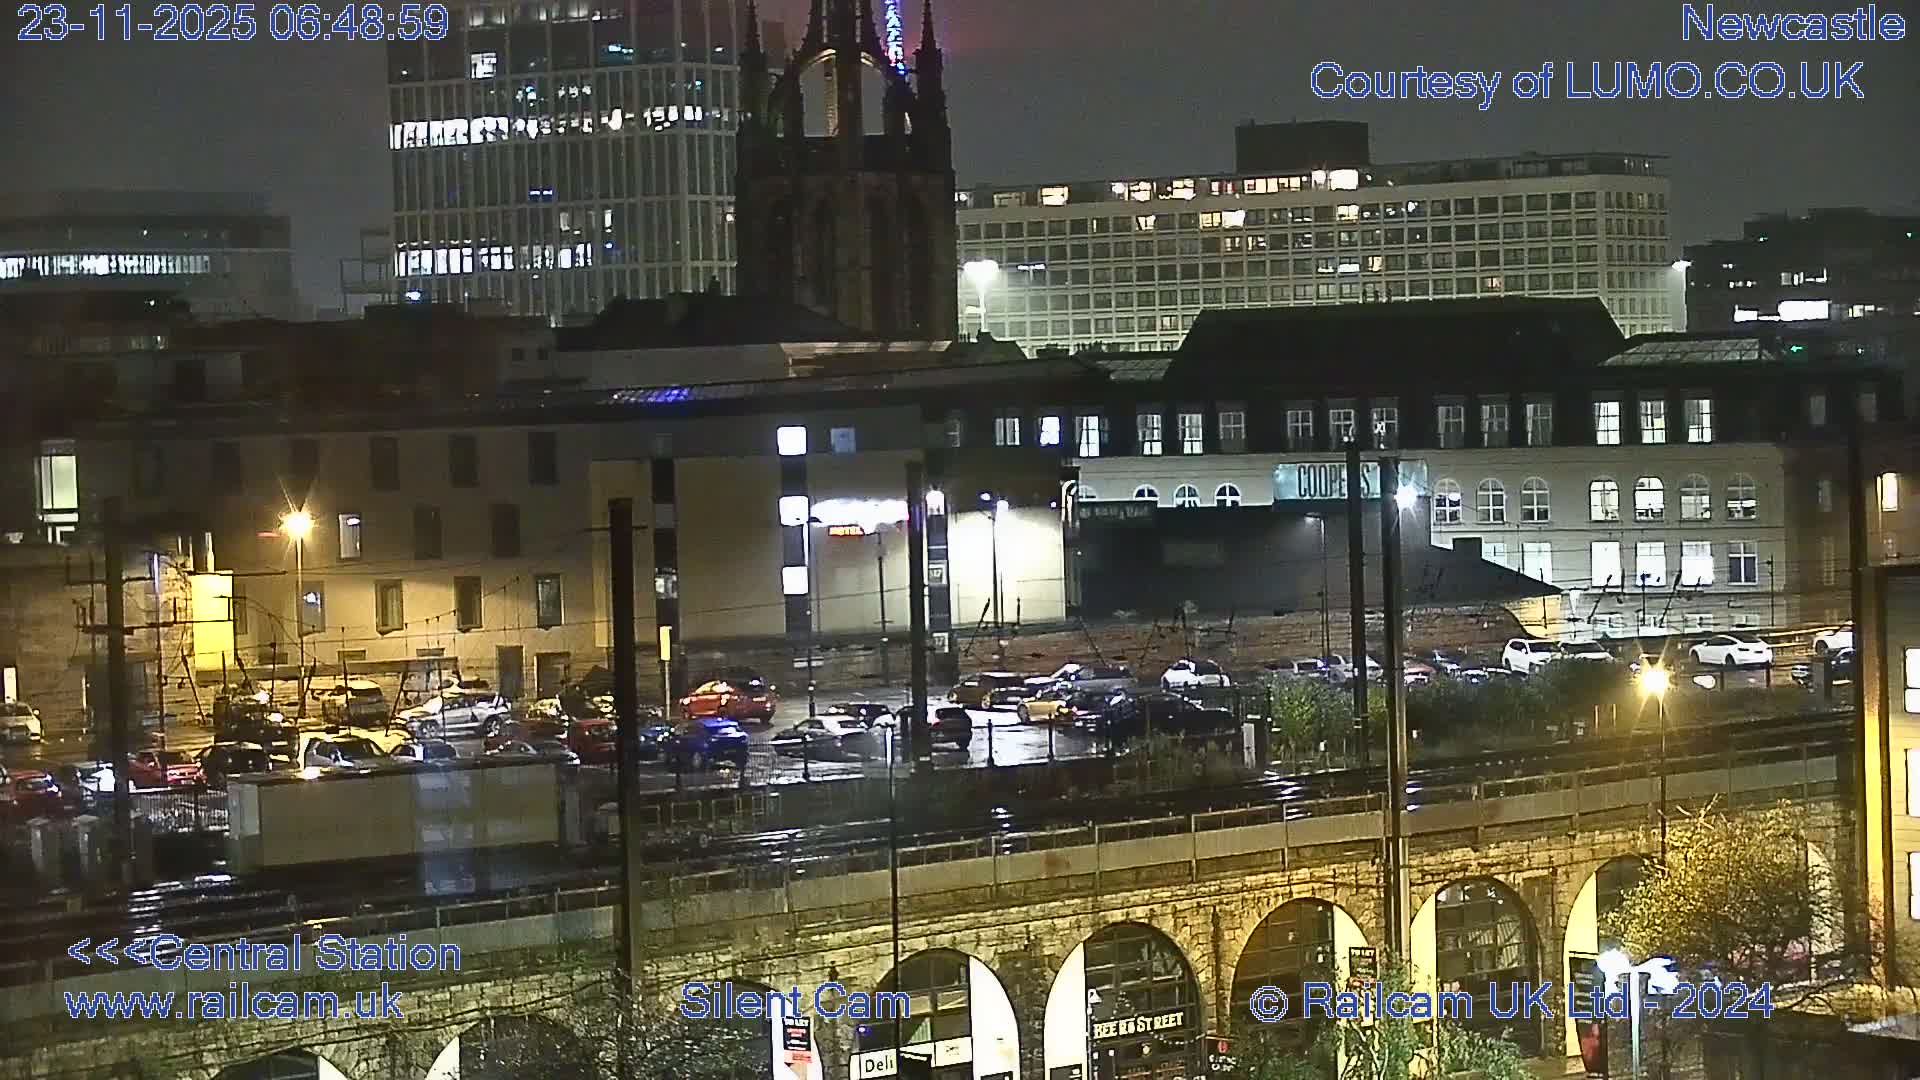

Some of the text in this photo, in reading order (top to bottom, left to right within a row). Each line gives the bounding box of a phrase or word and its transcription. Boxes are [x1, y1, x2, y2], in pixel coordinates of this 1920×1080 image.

[1297, 463, 1371, 498] COOPES
[1136, 1011, 1184, 1033] STREET
[865, 1054, 894, 1073] Deli
